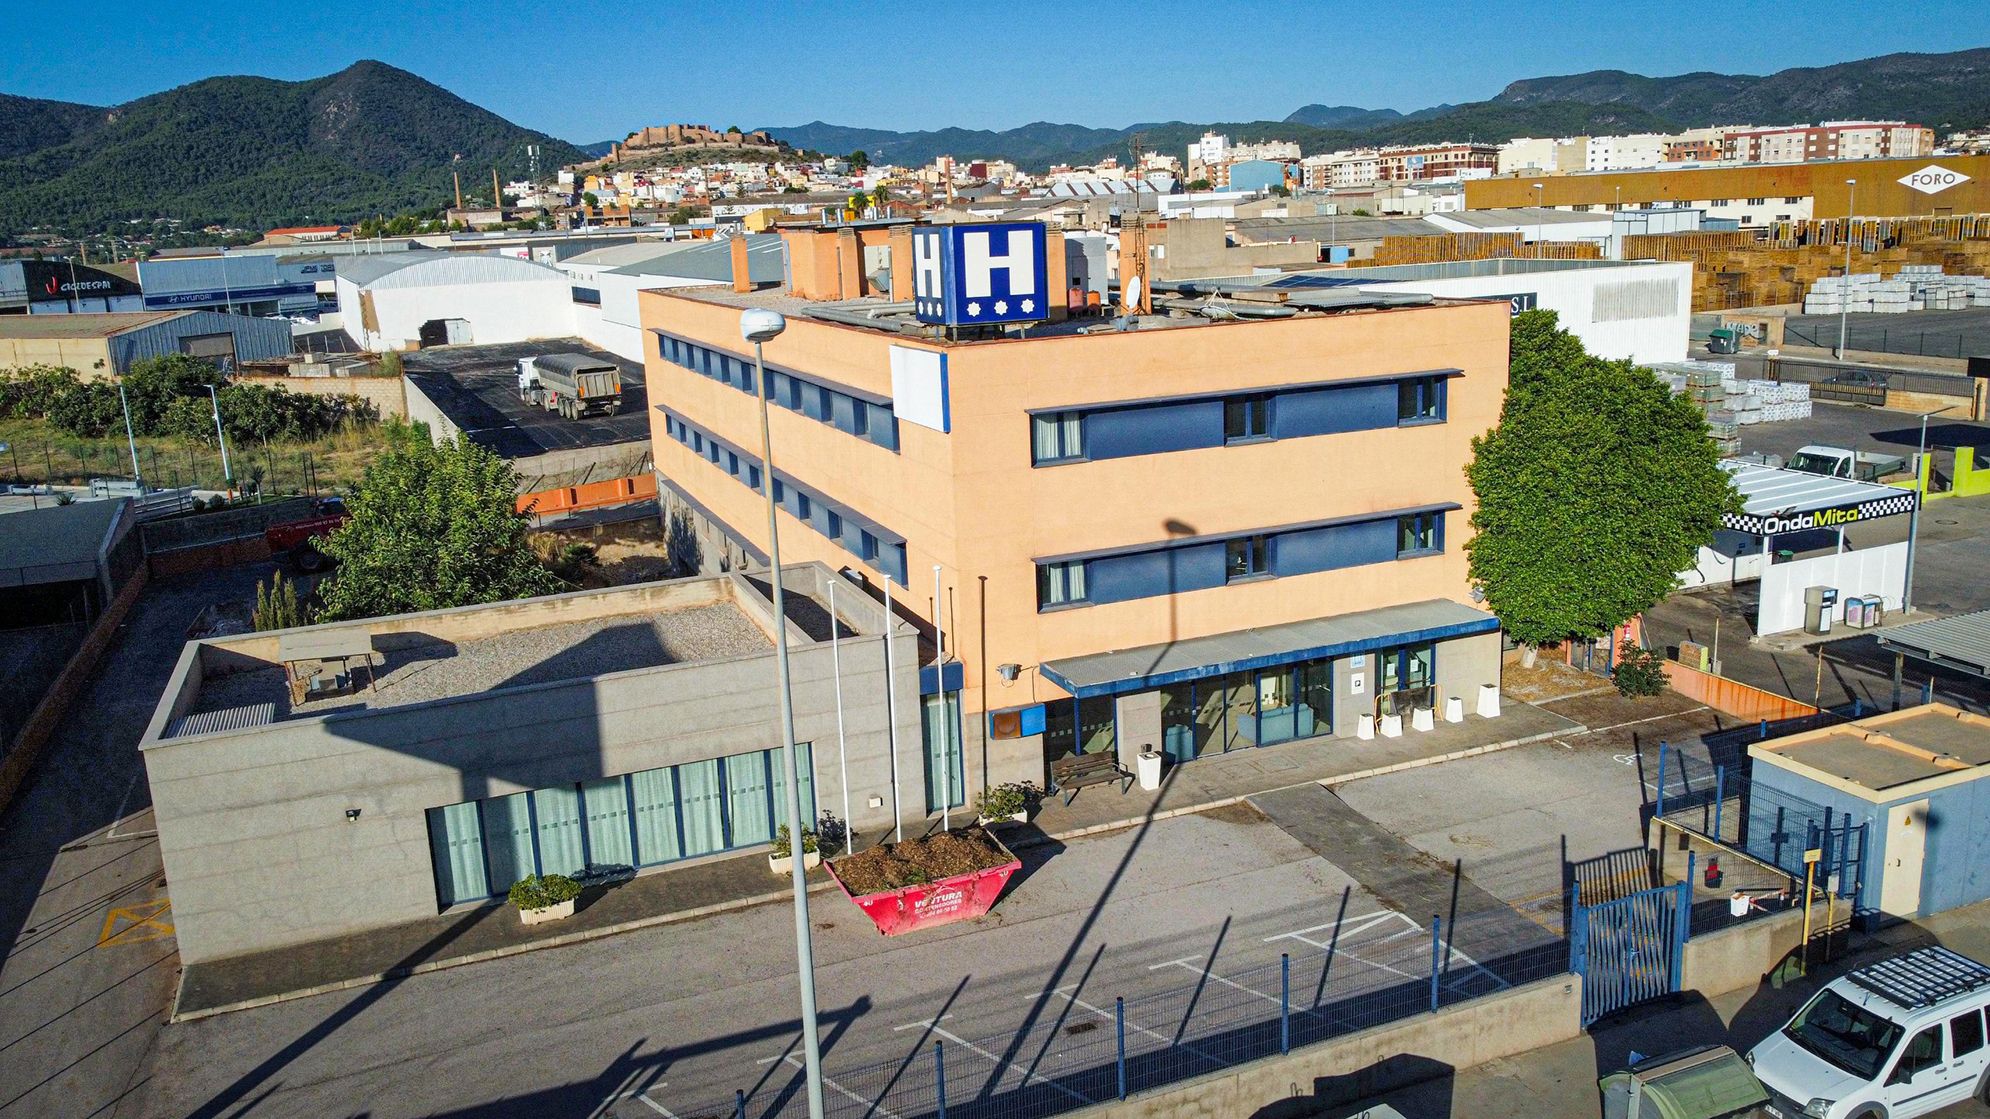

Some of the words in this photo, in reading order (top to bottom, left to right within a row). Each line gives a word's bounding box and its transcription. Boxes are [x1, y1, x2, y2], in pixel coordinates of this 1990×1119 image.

[1911, 173, 1956, 186] FORO
[914, 233, 942, 299] H
[963, 229, 1035, 298] H
[180, 293, 212, 302] HYUNDAI
[1764, 508, 1859, 534] OndaMita
